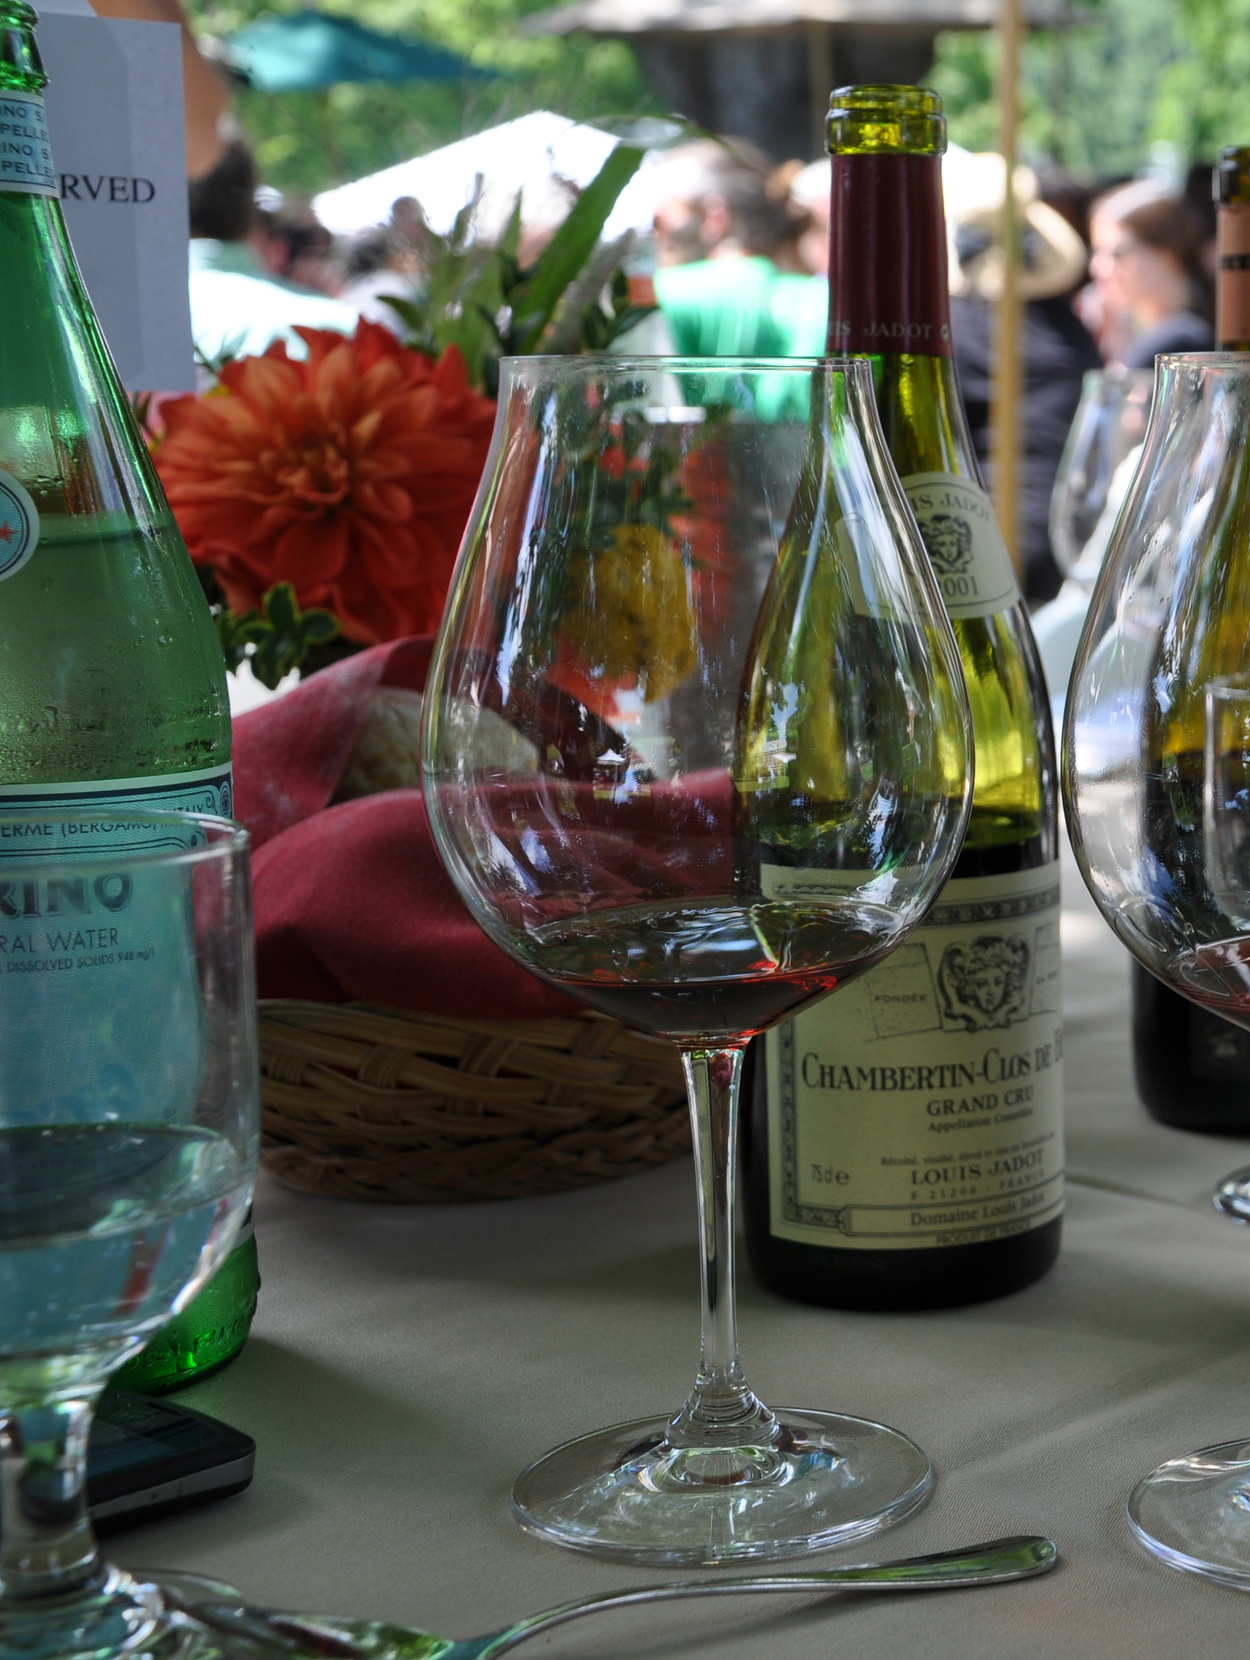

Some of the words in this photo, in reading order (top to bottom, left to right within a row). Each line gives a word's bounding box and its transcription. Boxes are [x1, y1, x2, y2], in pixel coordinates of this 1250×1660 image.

[60, 173, 156, 204] RVED
[864, 322, 933, 340] JADOT
[1, 822, 53, 837] ERME
[46, 927, 119, 951] WATER
[7, 958, 73, 973] DISSOLVED
[77, 954, 115, 968] SOLIDS
[874, 991, 927, 1002] FONDÉE
[927, 1093, 998, 1116] GRAND
[1004, 1085, 1035, 1106] CRU
[928, 1117, 992, 1135] Appellation
[910, 1164, 982, 1186] LOUIS
[988, 1148, 1044, 1177] JADOT
[910, 1209, 979, 1226] Domaine
[982, 1201, 1016, 1217] Louis
